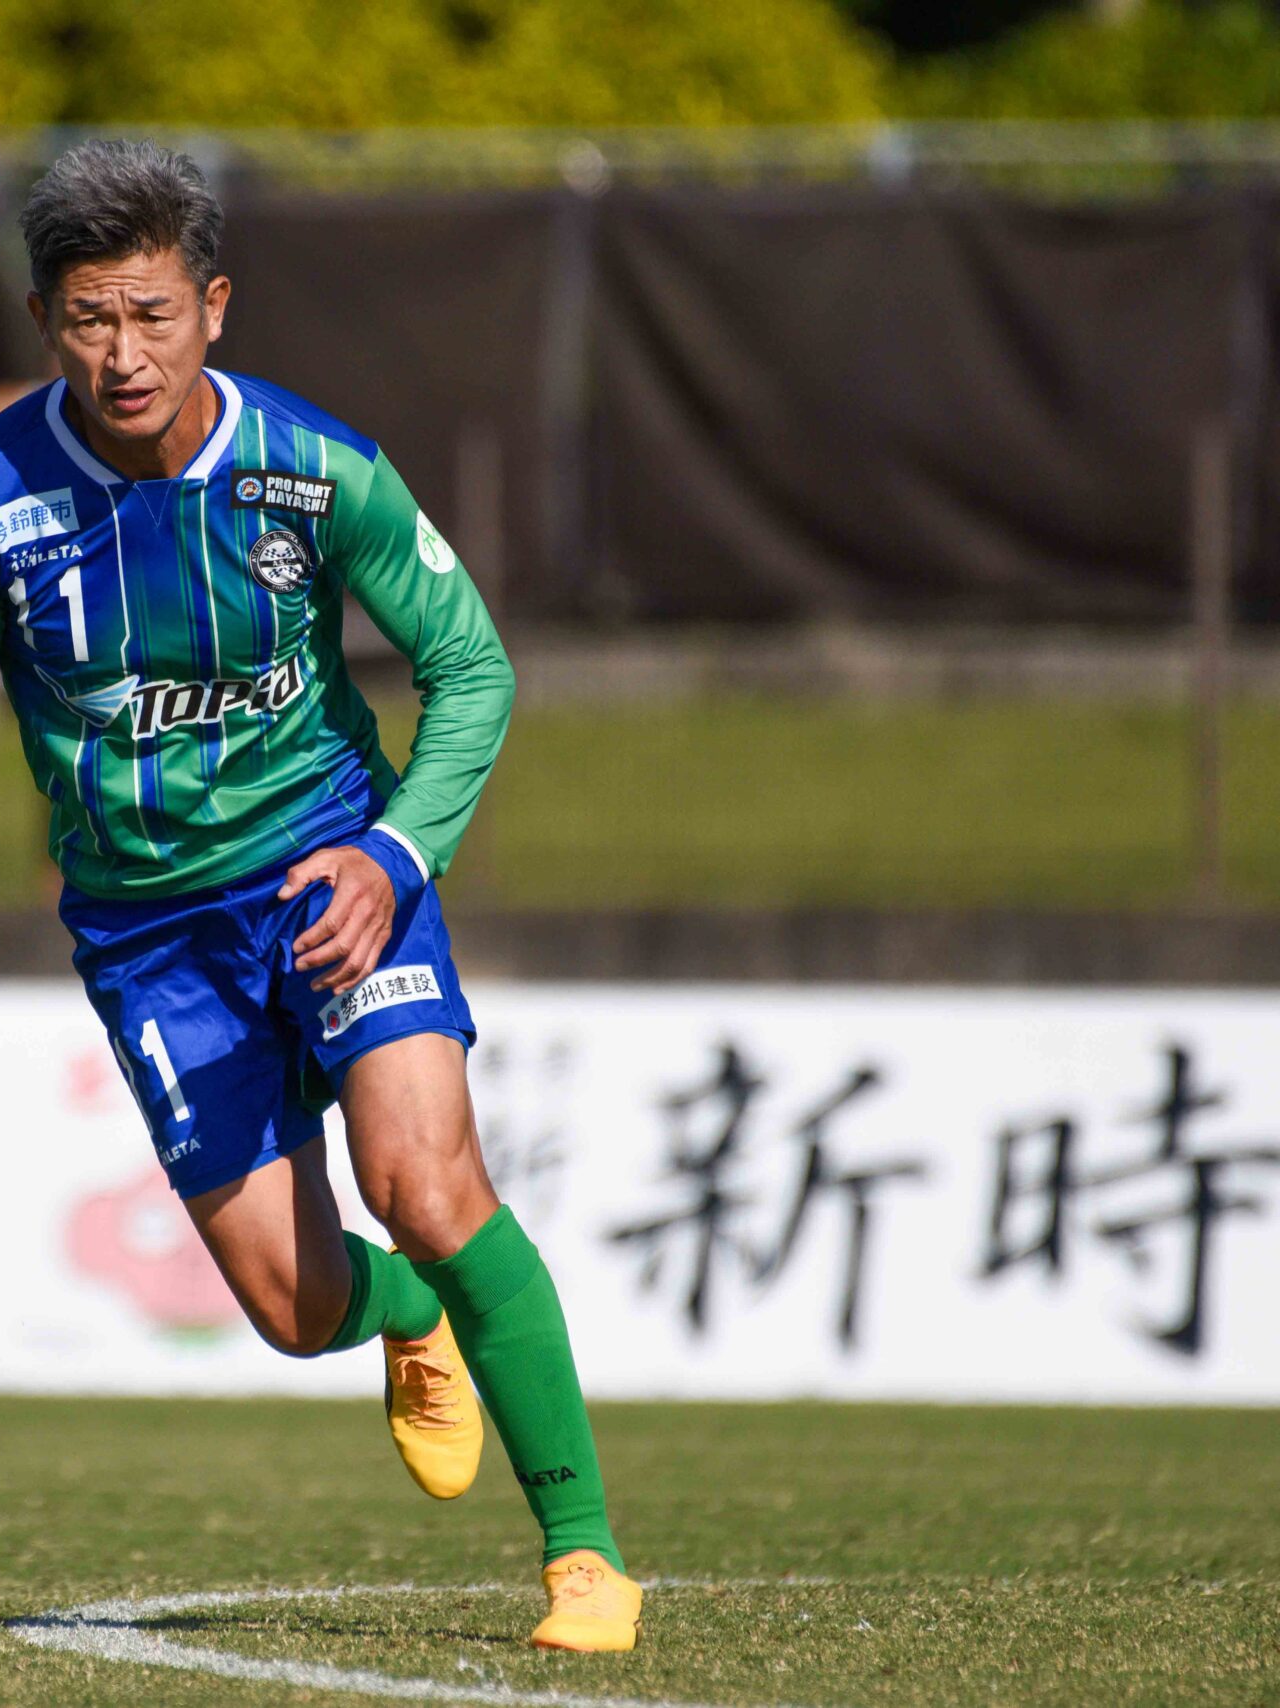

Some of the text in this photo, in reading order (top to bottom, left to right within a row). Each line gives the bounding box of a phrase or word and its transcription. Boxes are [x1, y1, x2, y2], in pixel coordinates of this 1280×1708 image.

[265, 489, 328, 513] HAYASHI
[266, 476, 293, 493] PRO
[293, 480, 333, 500] MART
[8, 499, 71, 534] 鈴鹿市
[11, 544, 83, 572] ATHLETA
[8, 565, 90, 662] 11
[340, 973, 435, 1021] 勢州建設
[603, 1028, 1280, 1360] 新時
